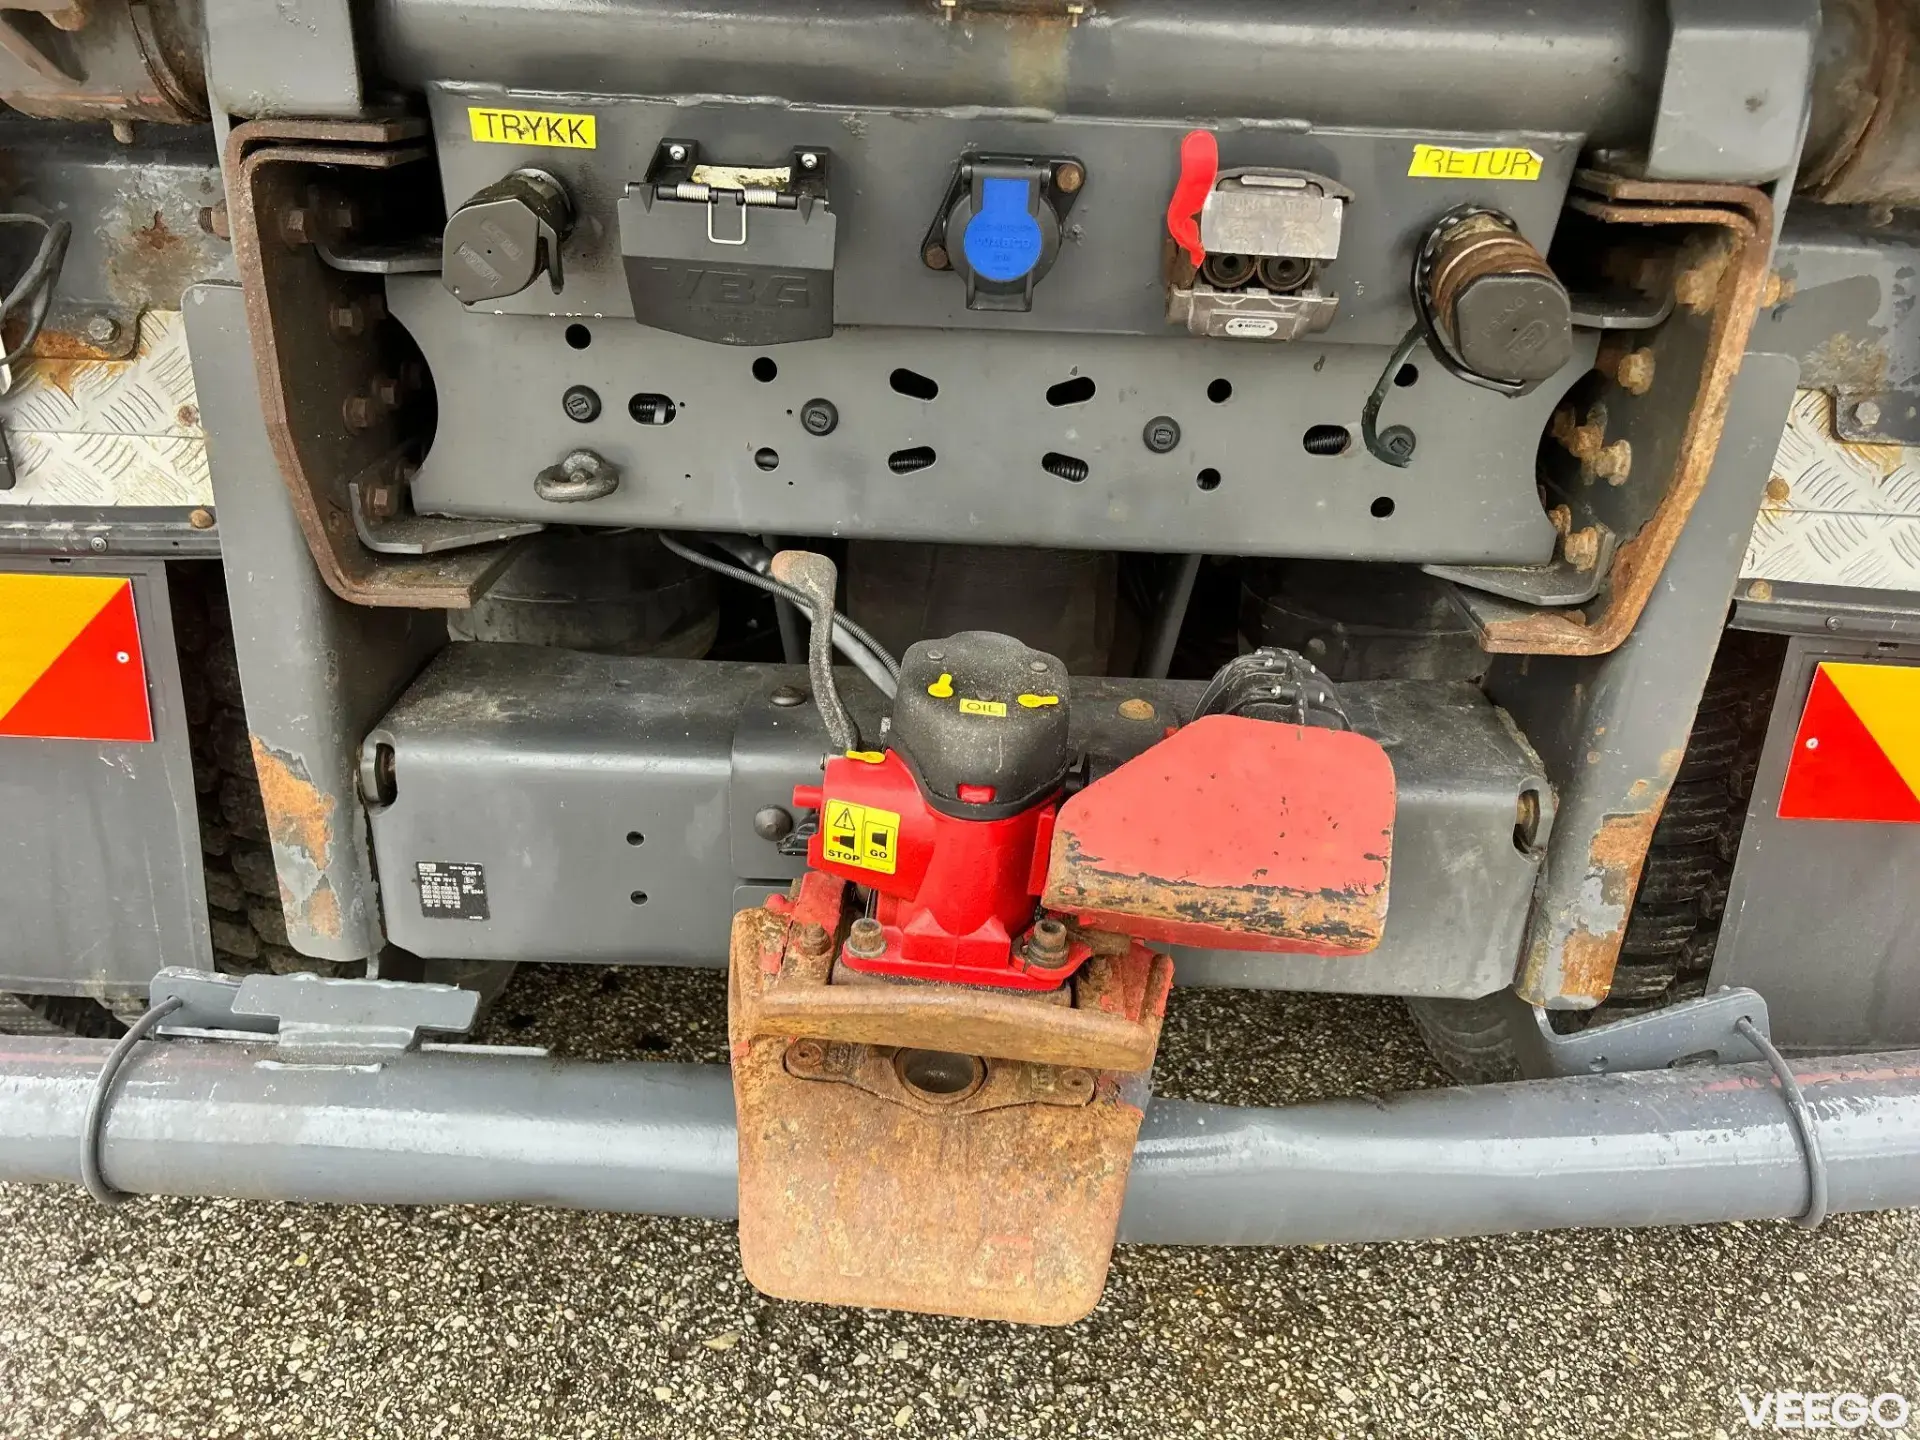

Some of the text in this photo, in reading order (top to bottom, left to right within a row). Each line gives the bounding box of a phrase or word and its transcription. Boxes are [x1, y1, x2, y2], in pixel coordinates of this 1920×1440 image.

[479, 112, 588, 145] TRYKK
[1424, 148, 1532, 177] RETUR
[966, 702, 999, 713] OIL
[828, 849, 888, 862] STOP GO
